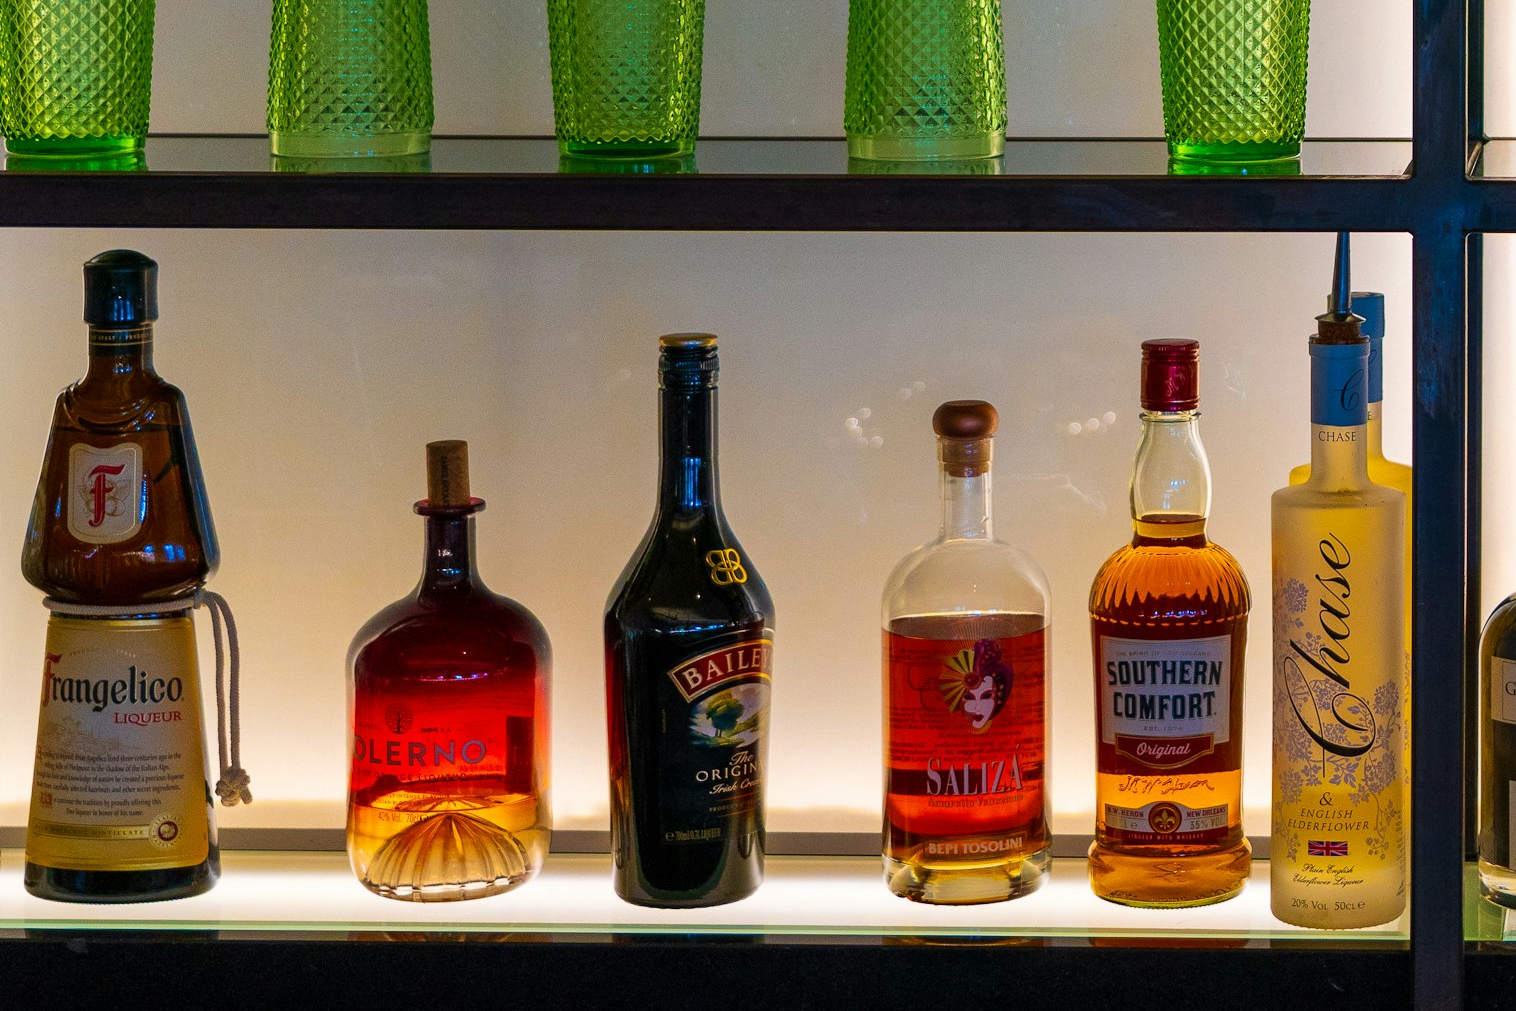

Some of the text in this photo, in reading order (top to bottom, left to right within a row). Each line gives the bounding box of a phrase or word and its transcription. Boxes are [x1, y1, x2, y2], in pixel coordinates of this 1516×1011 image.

[1318, 431, 1356, 442] CHASE
[1284, 533, 1376, 779] Chase
[682, 648, 770, 689] BAILEY
[1107, 660, 1223, 686] SOUTHERN
[42, 653, 183, 712] Frangelico
[114, 712, 182, 726] LIQUEUR
[354, 736, 486, 767] OLERNO
[1136, 742, 1190, 759] Original
[729, 751, 754, 766] The
[696, 763, 759, 781] ORIGIN
[709, 782, 737, 794] Irish
[1319, 792, 1333, 805] &
[1187, 807, 1226, 818] NEW ORLEANS
[1300, 809, 1353, 819] ENGLISH
[1288, 819, 1369, 832] ELDERFLOWER
[929, 837, 1023, 855] BEPI TOSOLINI
[1302, 864, 1354, 876] Plain English
[1292, 874, 1363, 888] Elderflower Liqueur
